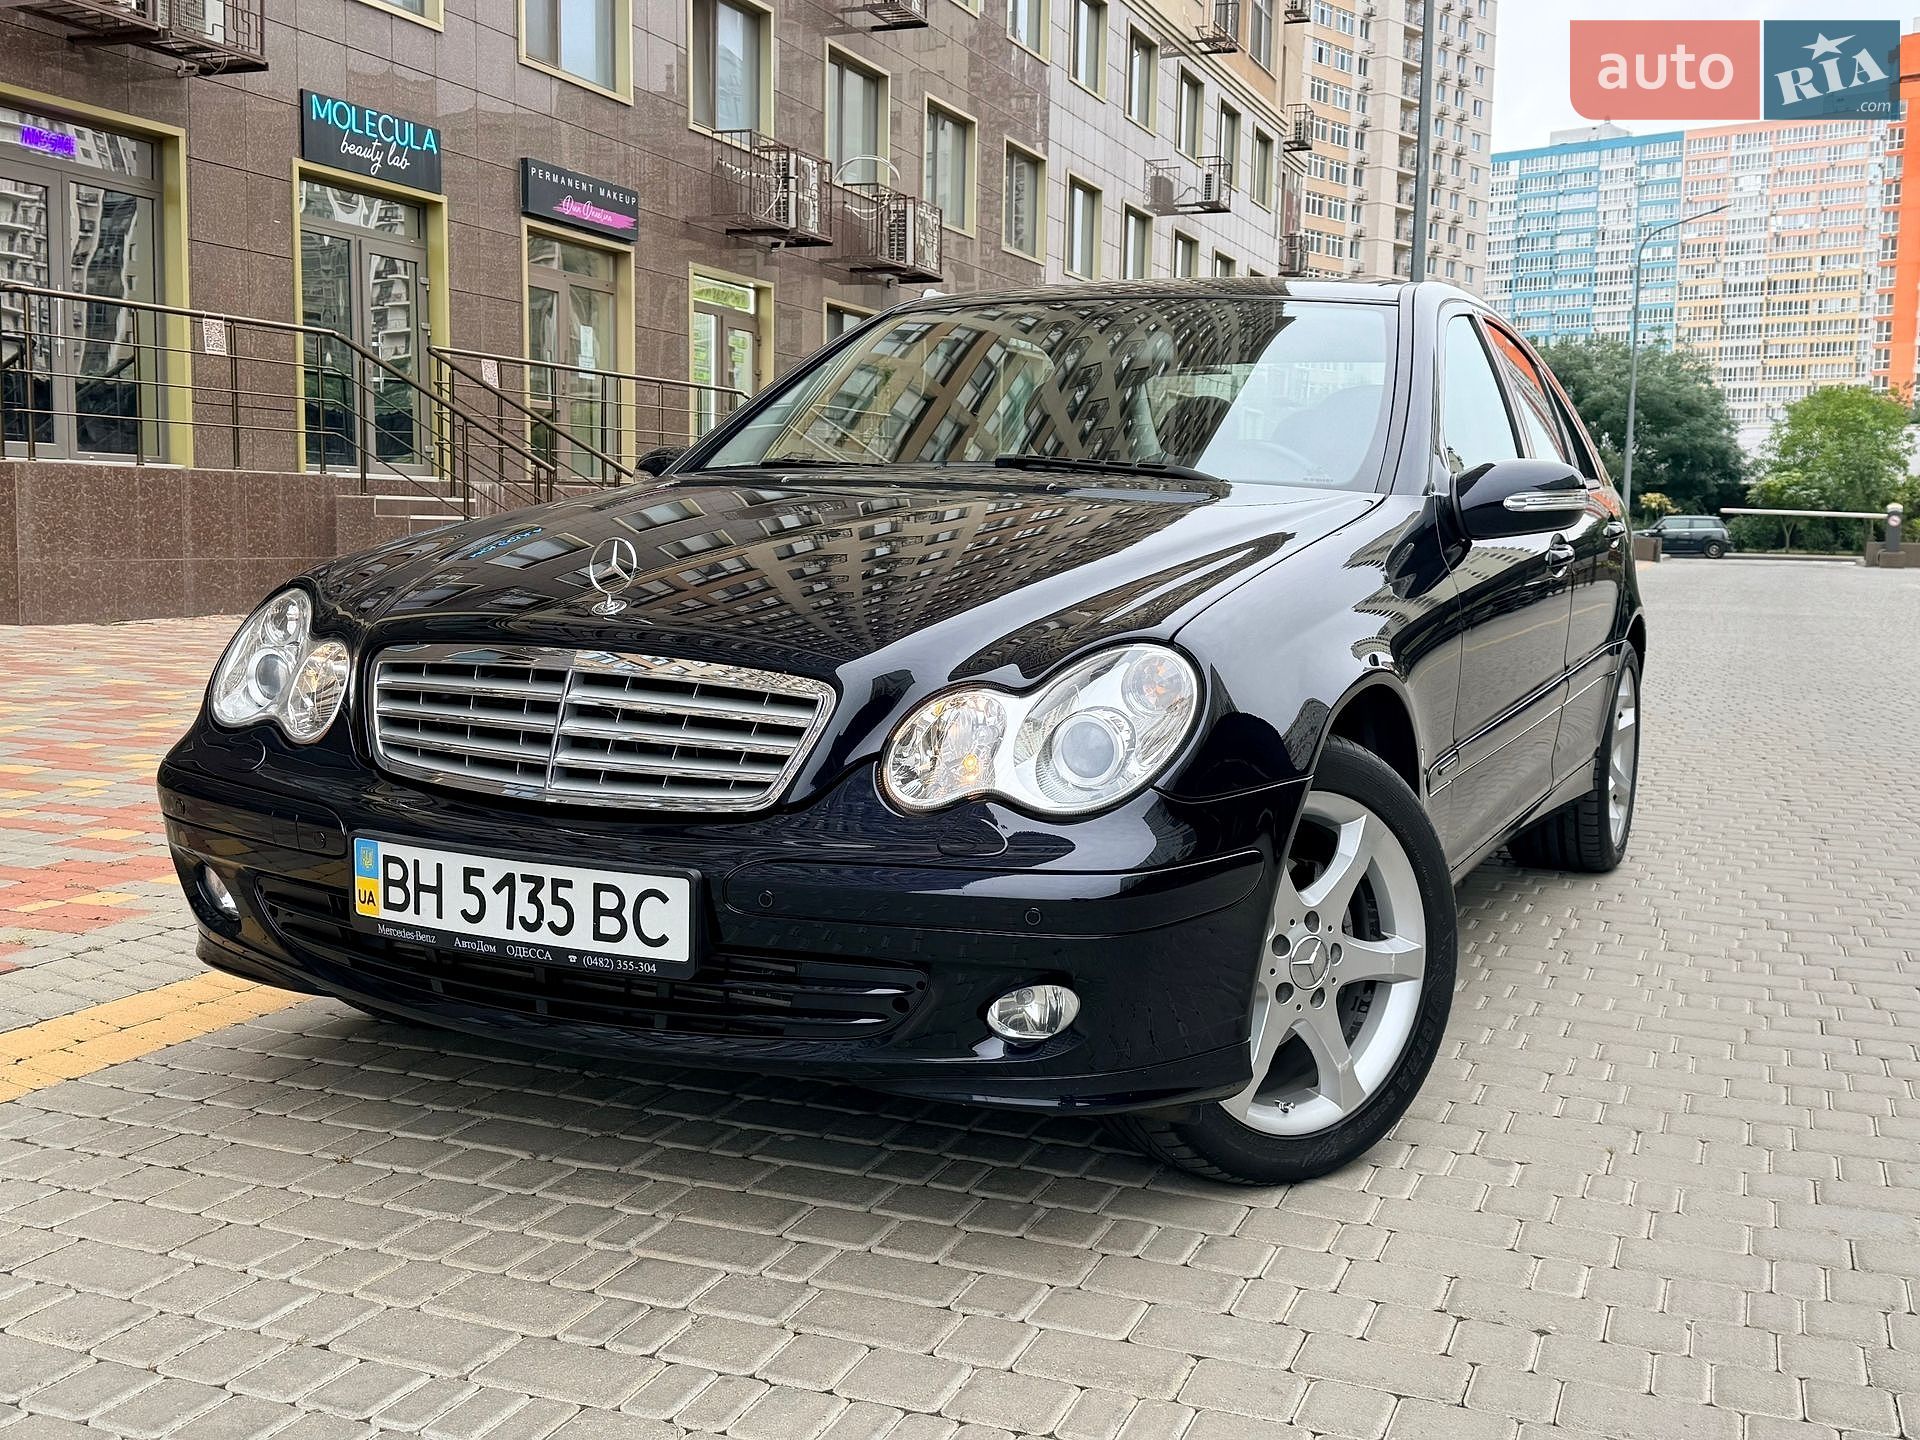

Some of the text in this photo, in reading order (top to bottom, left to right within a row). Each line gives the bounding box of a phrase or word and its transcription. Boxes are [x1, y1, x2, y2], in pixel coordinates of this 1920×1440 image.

[311, 94, 438, 155] MOLECULA
[340, 129, 411, 175] beauty lab
[530, 167, 637, 205] PERMANENT MAKEUP
[358, 889, 377, 907] UA
[382, 854, 670, 948] BH 5135 BC
[453, 937, 497, 953] АвтоДом
[506, 944, 553, 961] ОДЕССА
[582, 955, 615, 971] (0482)
[616, 959, 657, 974] 355-304
